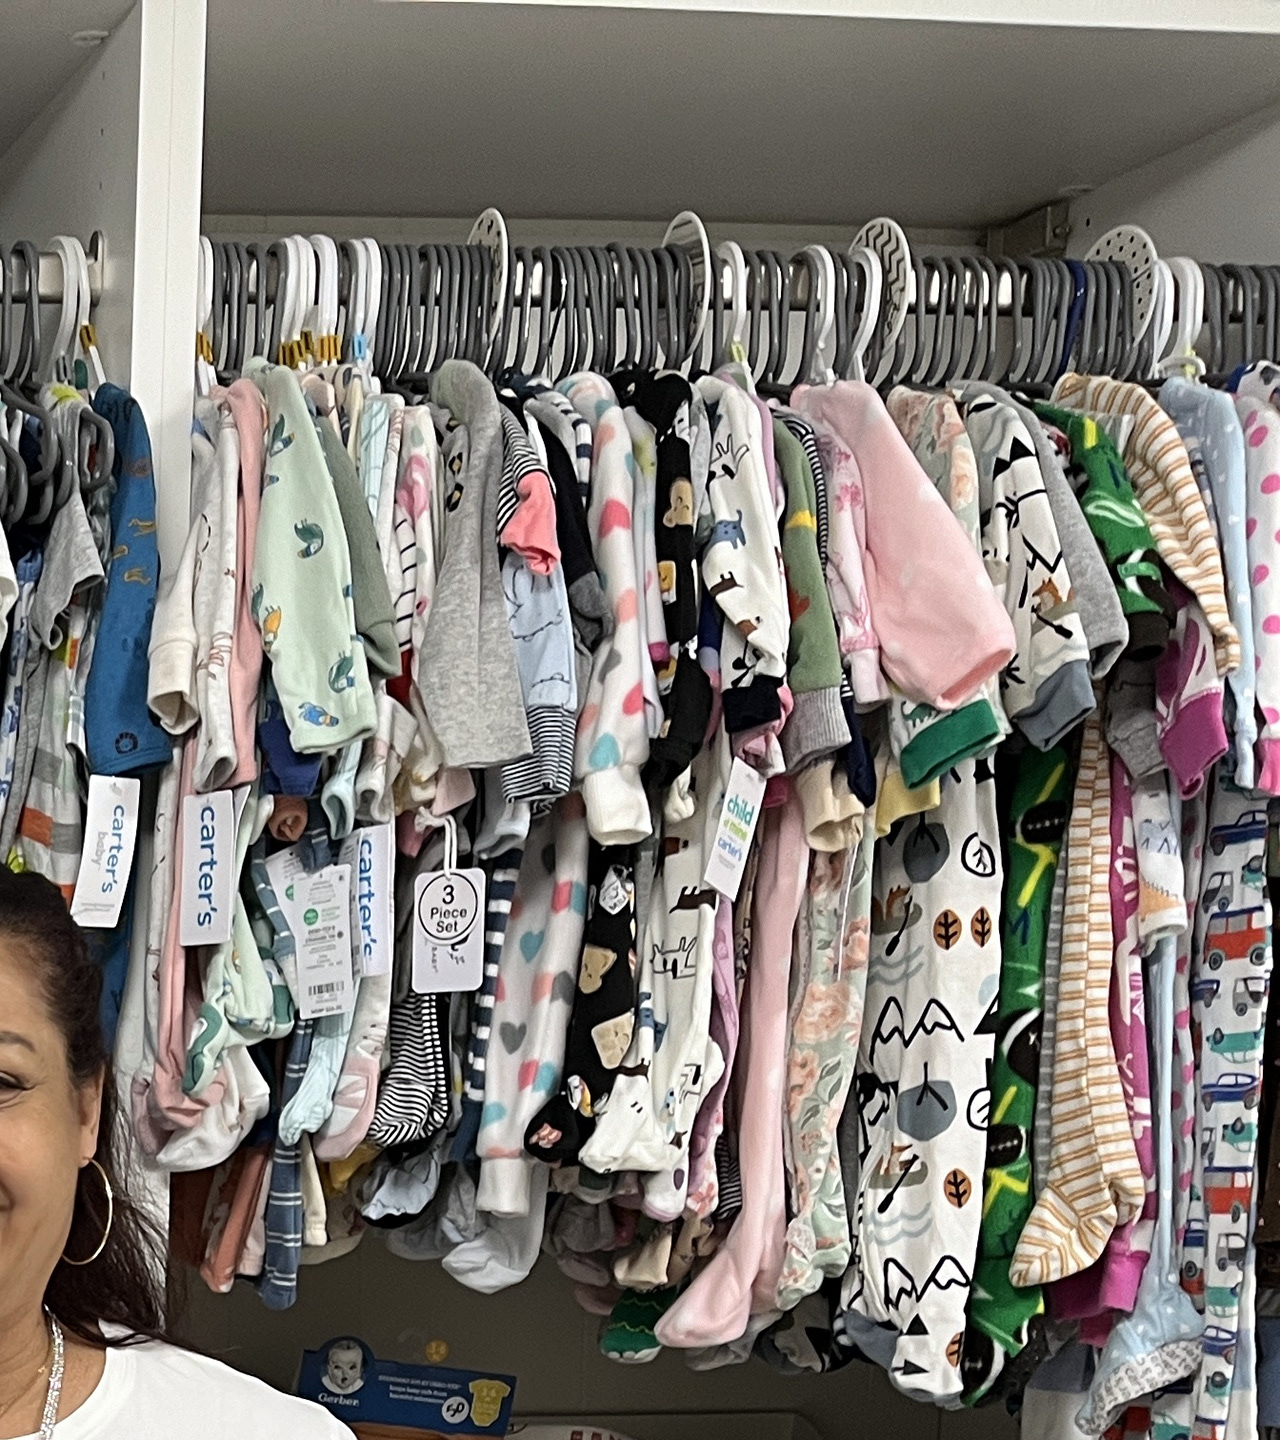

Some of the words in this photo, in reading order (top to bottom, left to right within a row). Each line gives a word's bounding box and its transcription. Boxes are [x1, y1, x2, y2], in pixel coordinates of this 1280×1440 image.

[727, 794, 755, 827] child
[101, 804, 125, 893] carter's
[197, 806, 218, 927] carter's
[442, 884, 455, 905] 3
[430, 906, 468, 920] Piece
[436, 920, 458, 934] Set
[318, 1392, 360, 1408] Gerber
